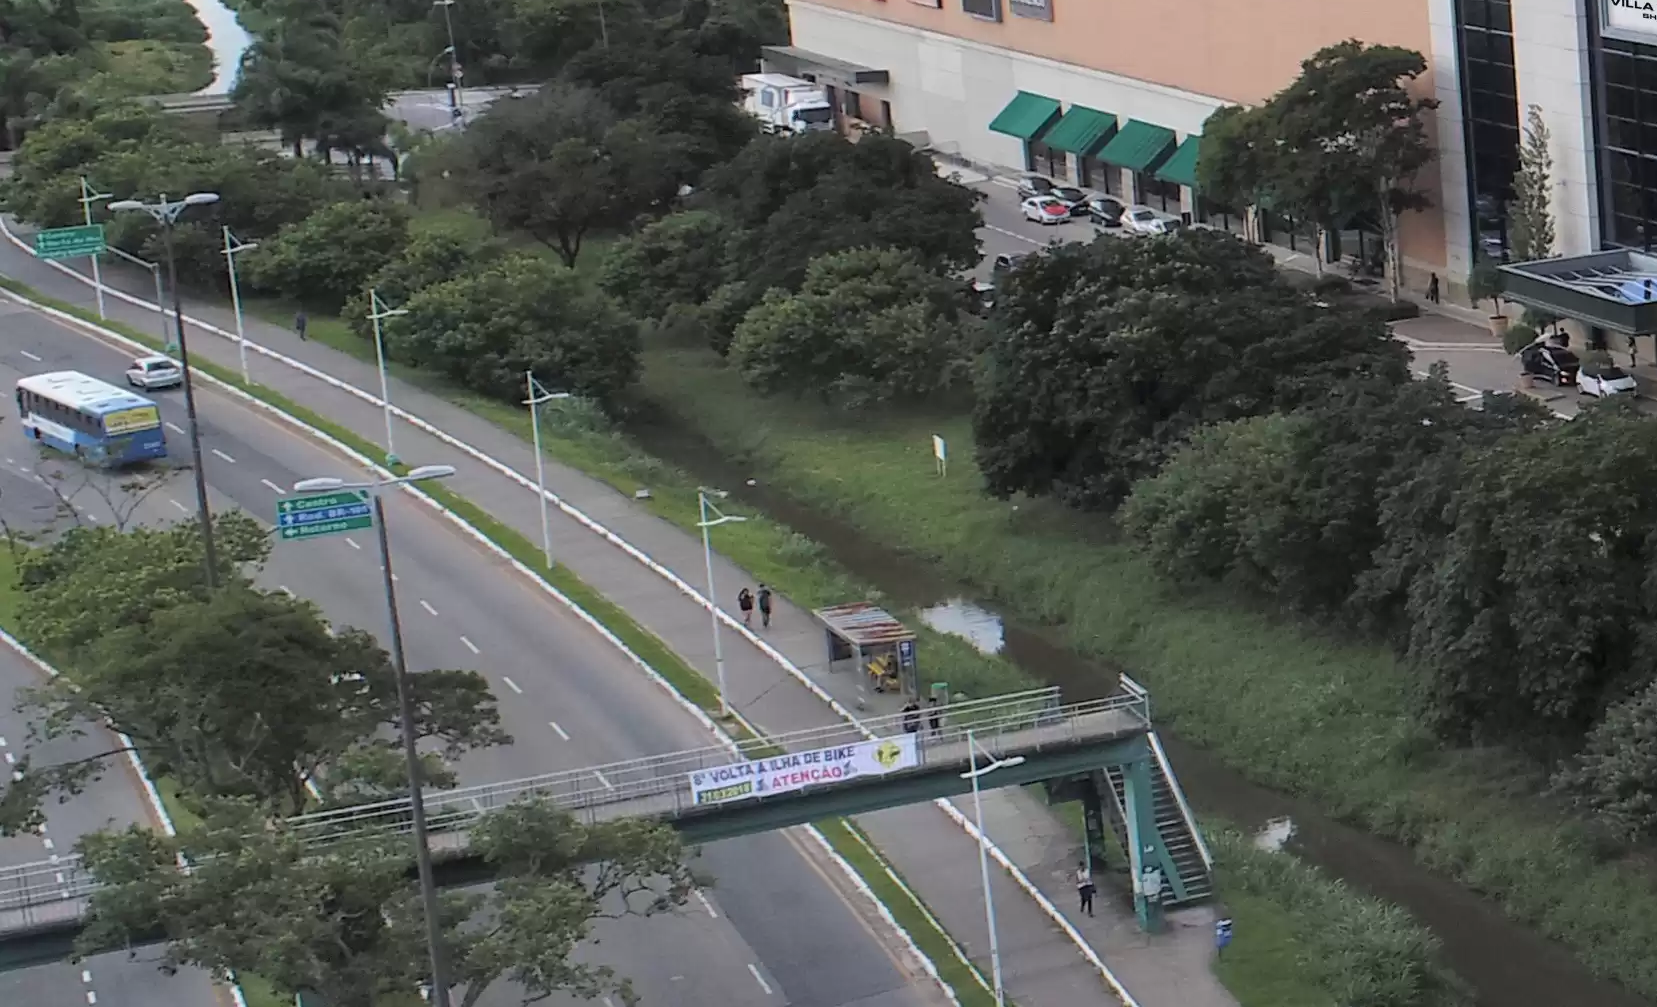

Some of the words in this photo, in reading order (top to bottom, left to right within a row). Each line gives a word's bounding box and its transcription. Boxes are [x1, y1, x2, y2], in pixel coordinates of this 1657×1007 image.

[710, 763, 754, 783] VOLTA
[771, 755, 801, 772] ILHA
[803, 752, 821, 764] DE
[824, 745, 856, 762] BIKE
[771, 765, 843, 790] ATENÇÃO
